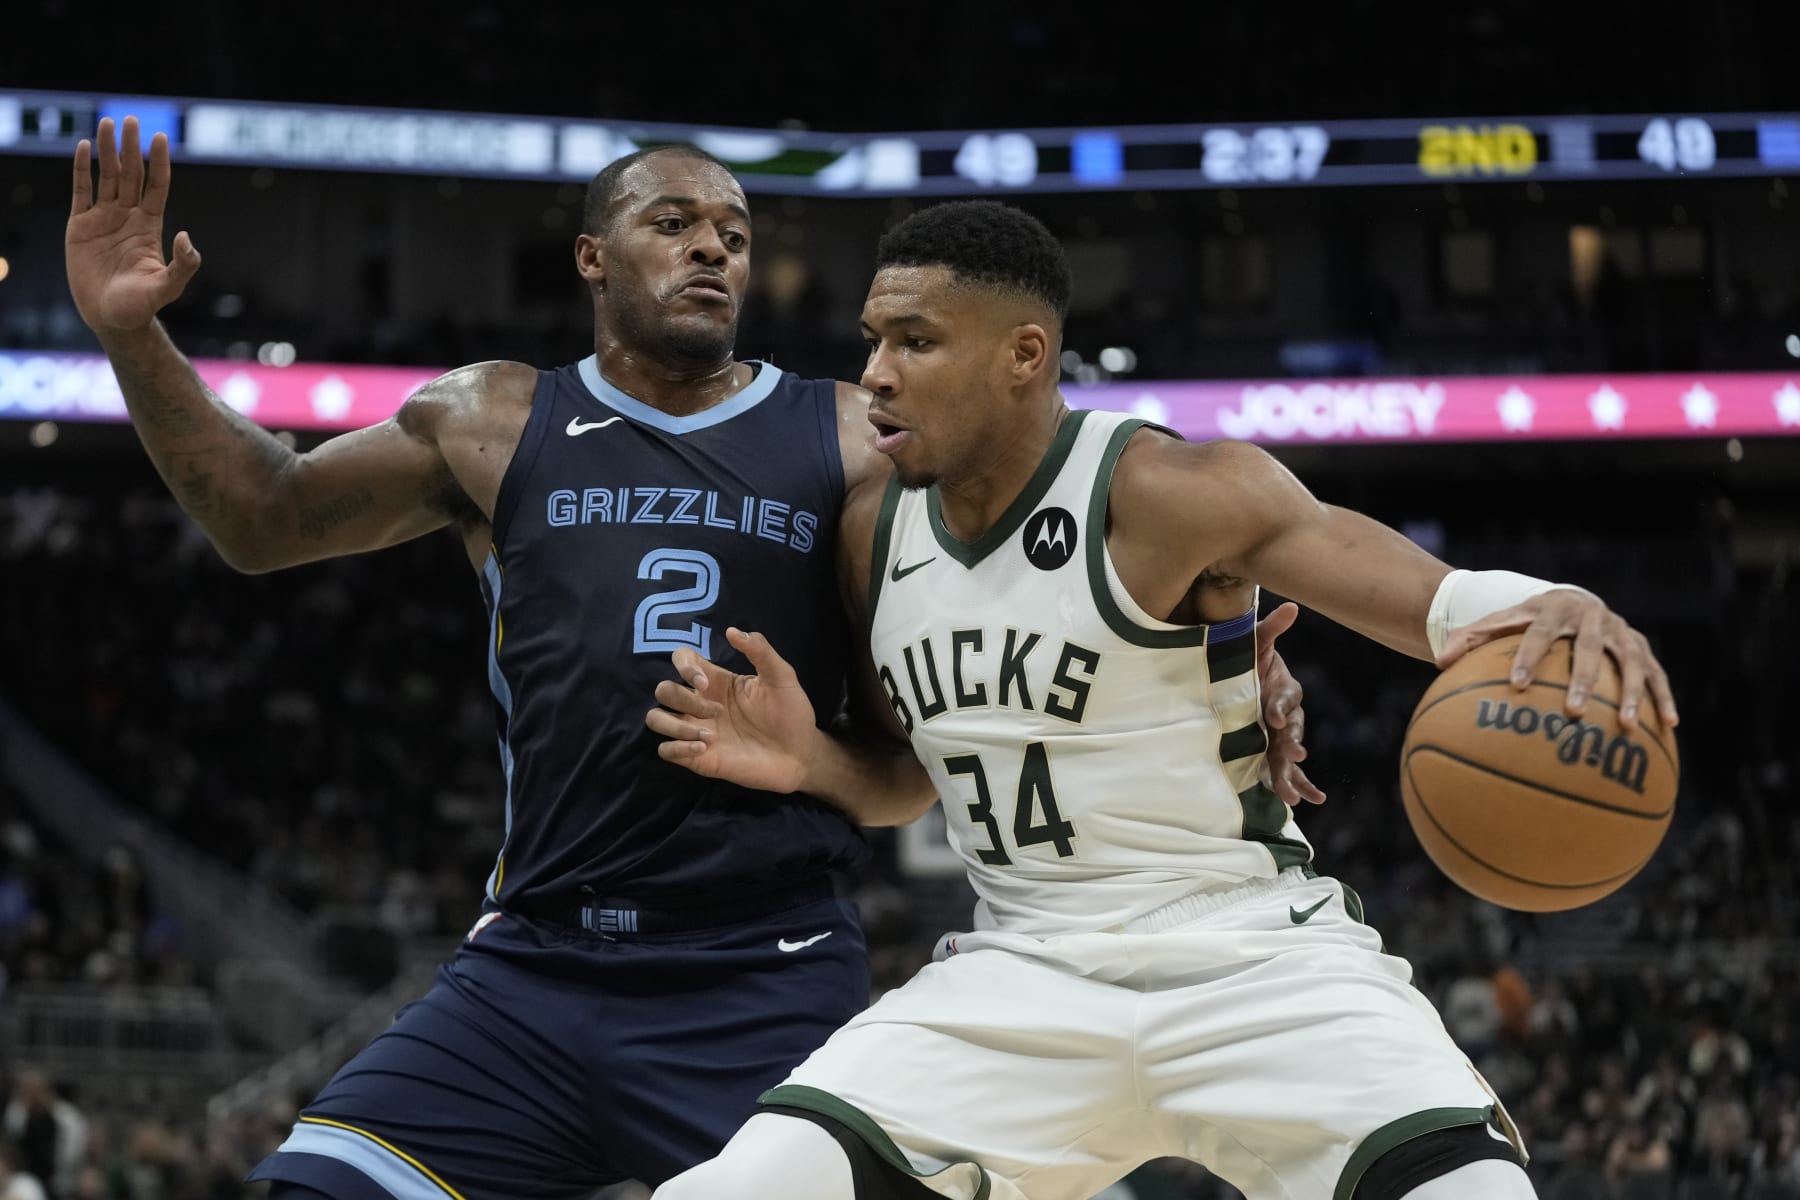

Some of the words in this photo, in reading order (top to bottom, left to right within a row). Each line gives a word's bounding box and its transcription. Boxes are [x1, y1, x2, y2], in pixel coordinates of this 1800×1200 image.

[1201, 125, 1329, 182] 2:37
[1418, 124, 1538, 176] 2ND
[1216, 381, 1446, 439] JOCKEY
[547, 486, 818, 554] GRIZZLIES
[633, 548, 721, 660] 2
[879, 626, 1101, 738] BUCKS
[1475, 697, 1649, 796] Wilson
[940, 738, 1079, 868] 34
